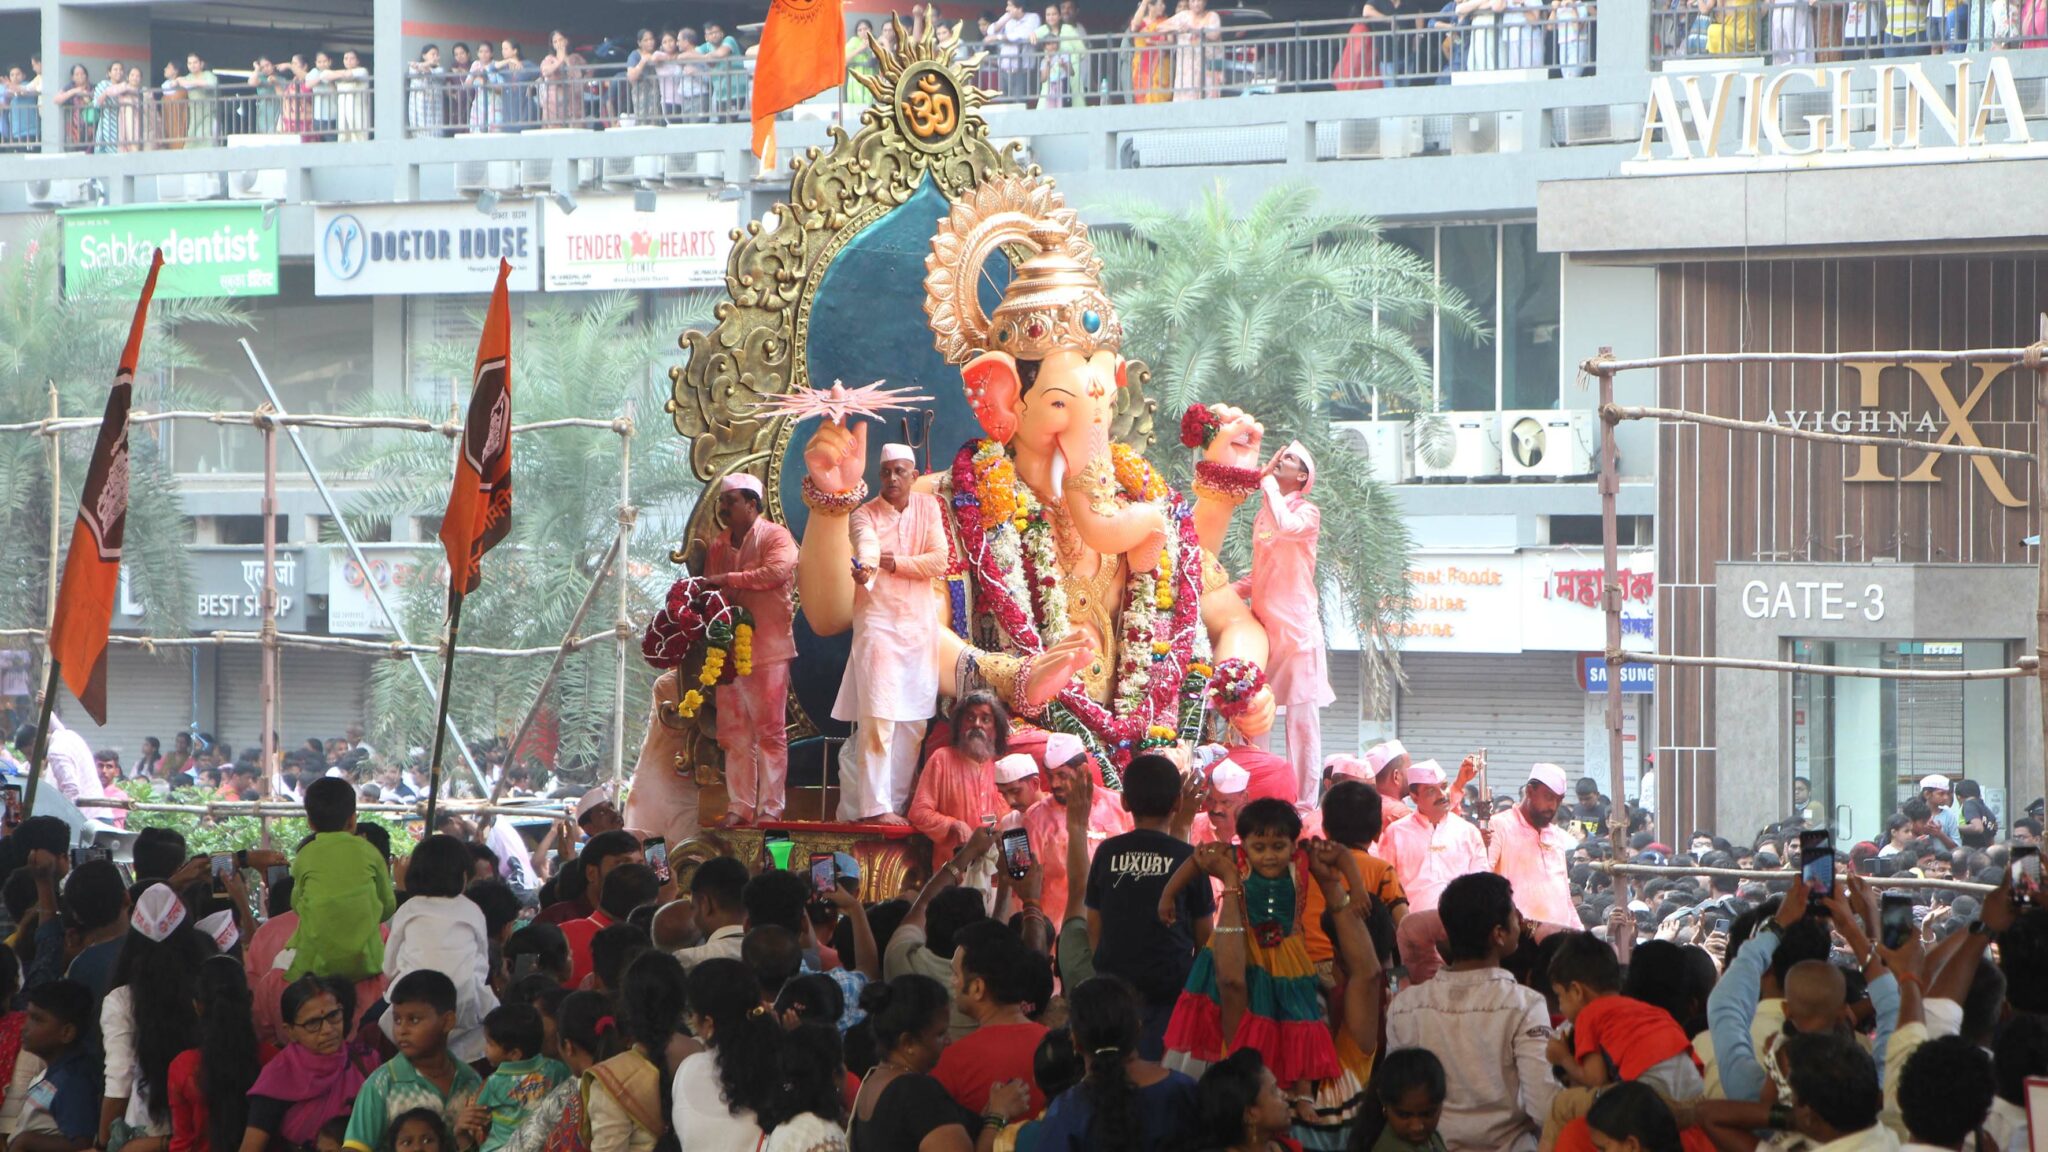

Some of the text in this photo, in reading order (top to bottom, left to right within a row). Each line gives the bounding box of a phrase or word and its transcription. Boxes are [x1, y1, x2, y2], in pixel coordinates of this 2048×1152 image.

[1632, 56, 2033, 161] AVIGHNA
[80, 225, 260, 269] Sabka dentist
[370, 226, 528, 262] DOCTOR HOUSE
[567, 230, 716, 261] TENDER HEARTS
[626, 262, 656, 274] CLINIC
[1764, 408, 1938, 434] AVIGHNA
[1841, 361, 2029, 508] IX
[1448, 566, 1504, 586] Foods
[198, 595, 240, 617] BEST
[1590, 667, 1654, 682] SASUNG
[1110, 854, 1174, 874] LUXURY
